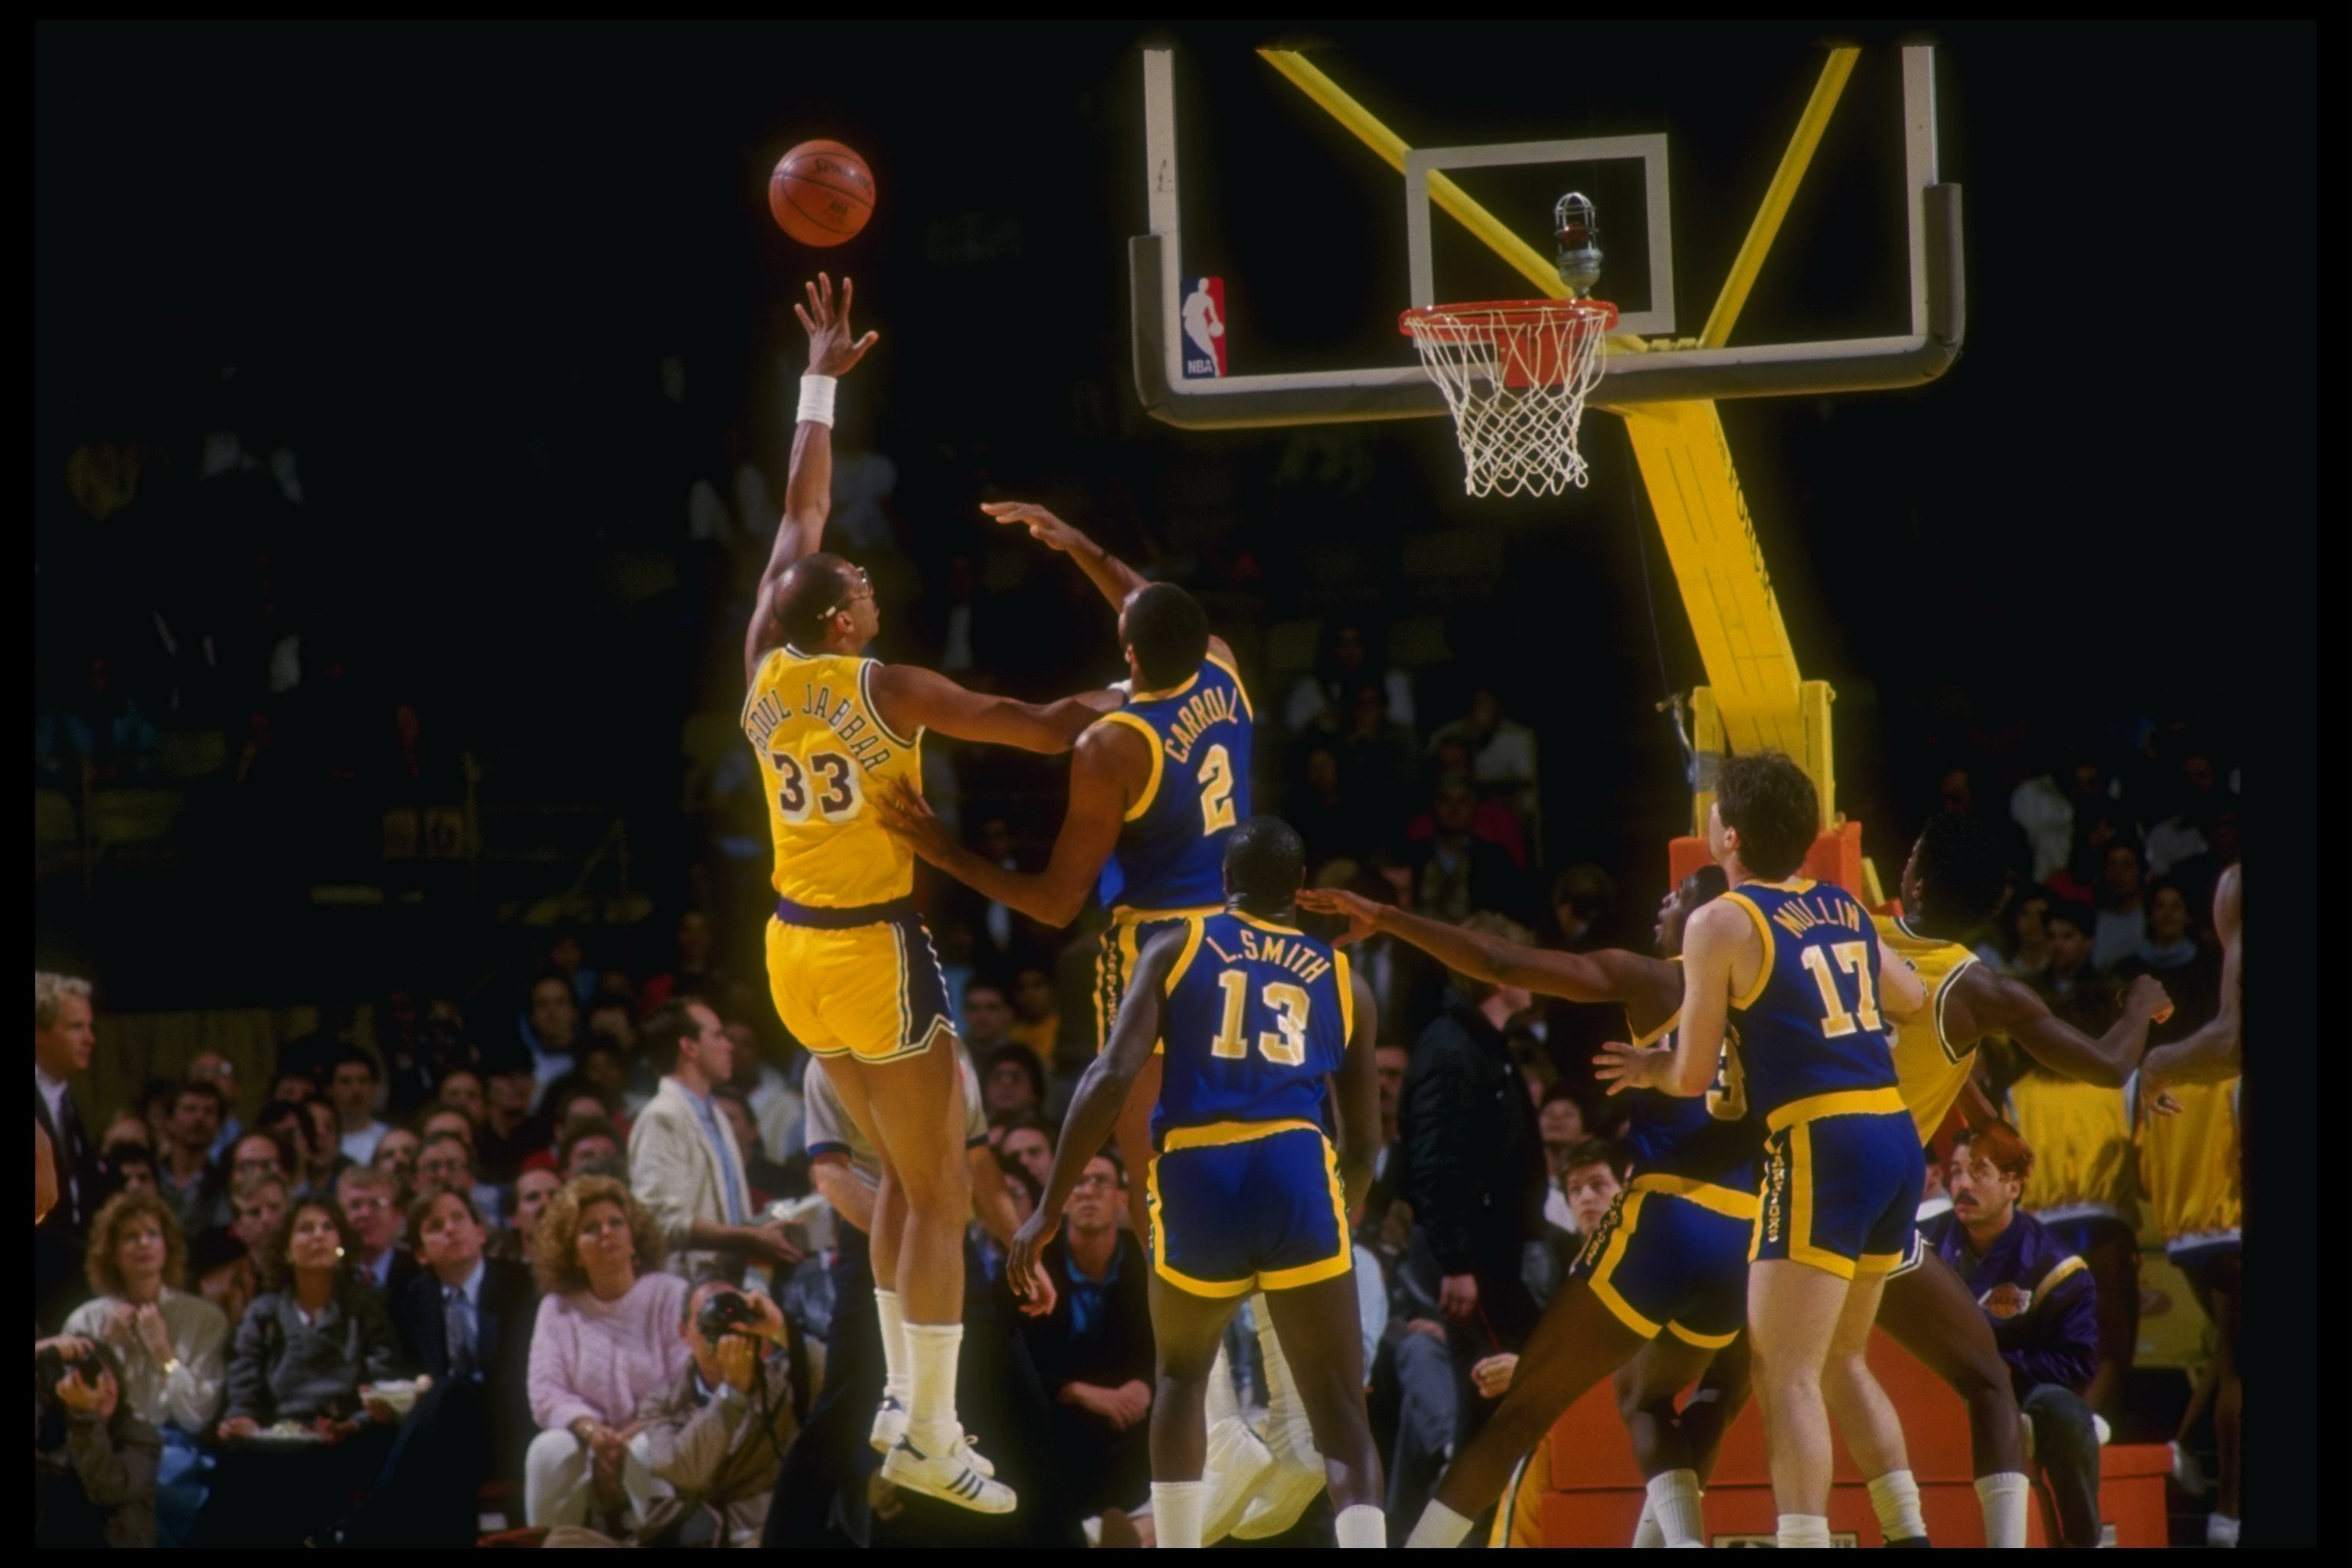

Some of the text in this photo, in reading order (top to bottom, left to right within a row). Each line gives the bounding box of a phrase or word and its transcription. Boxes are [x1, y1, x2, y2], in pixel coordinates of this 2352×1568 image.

[1187, 359, 1213, 374] NBA
[802, 683, 891, 771] JABBAR
[772, 751, 864, 824] 33
[1197, 743, 1237, 837] 2
[1772, 897, 1860, 939] MULLIN
[1210, 969, 1311, 1067] 13
[1801, 940, 1883, 1039] 17
